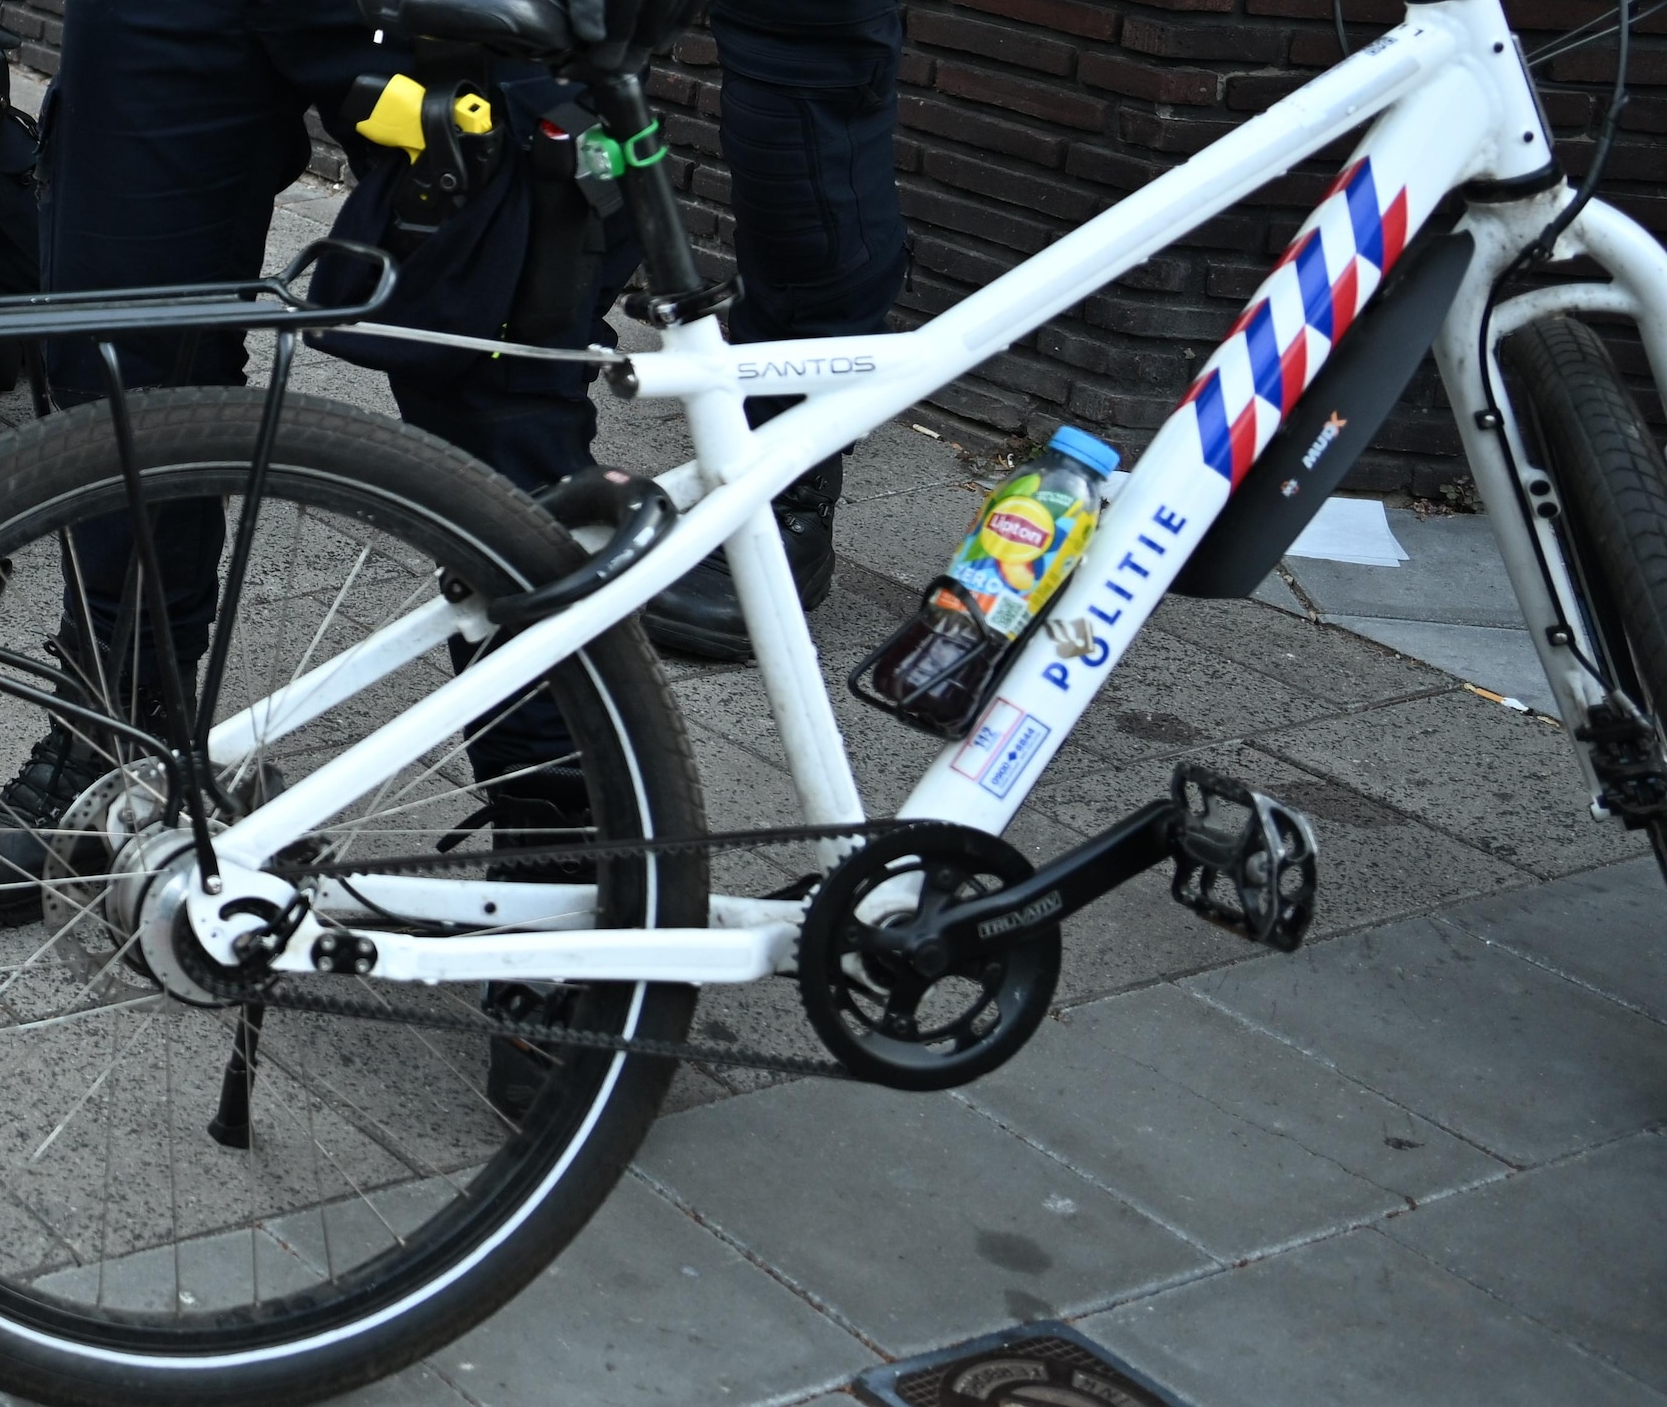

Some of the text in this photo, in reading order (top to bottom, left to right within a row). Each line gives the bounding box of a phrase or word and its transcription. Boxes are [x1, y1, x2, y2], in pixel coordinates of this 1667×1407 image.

[738, 355, 876, 379] SANTOS
[990, 513, 1043, 544] Lipton
[1041, 505, 1187, 691] POLITIE
